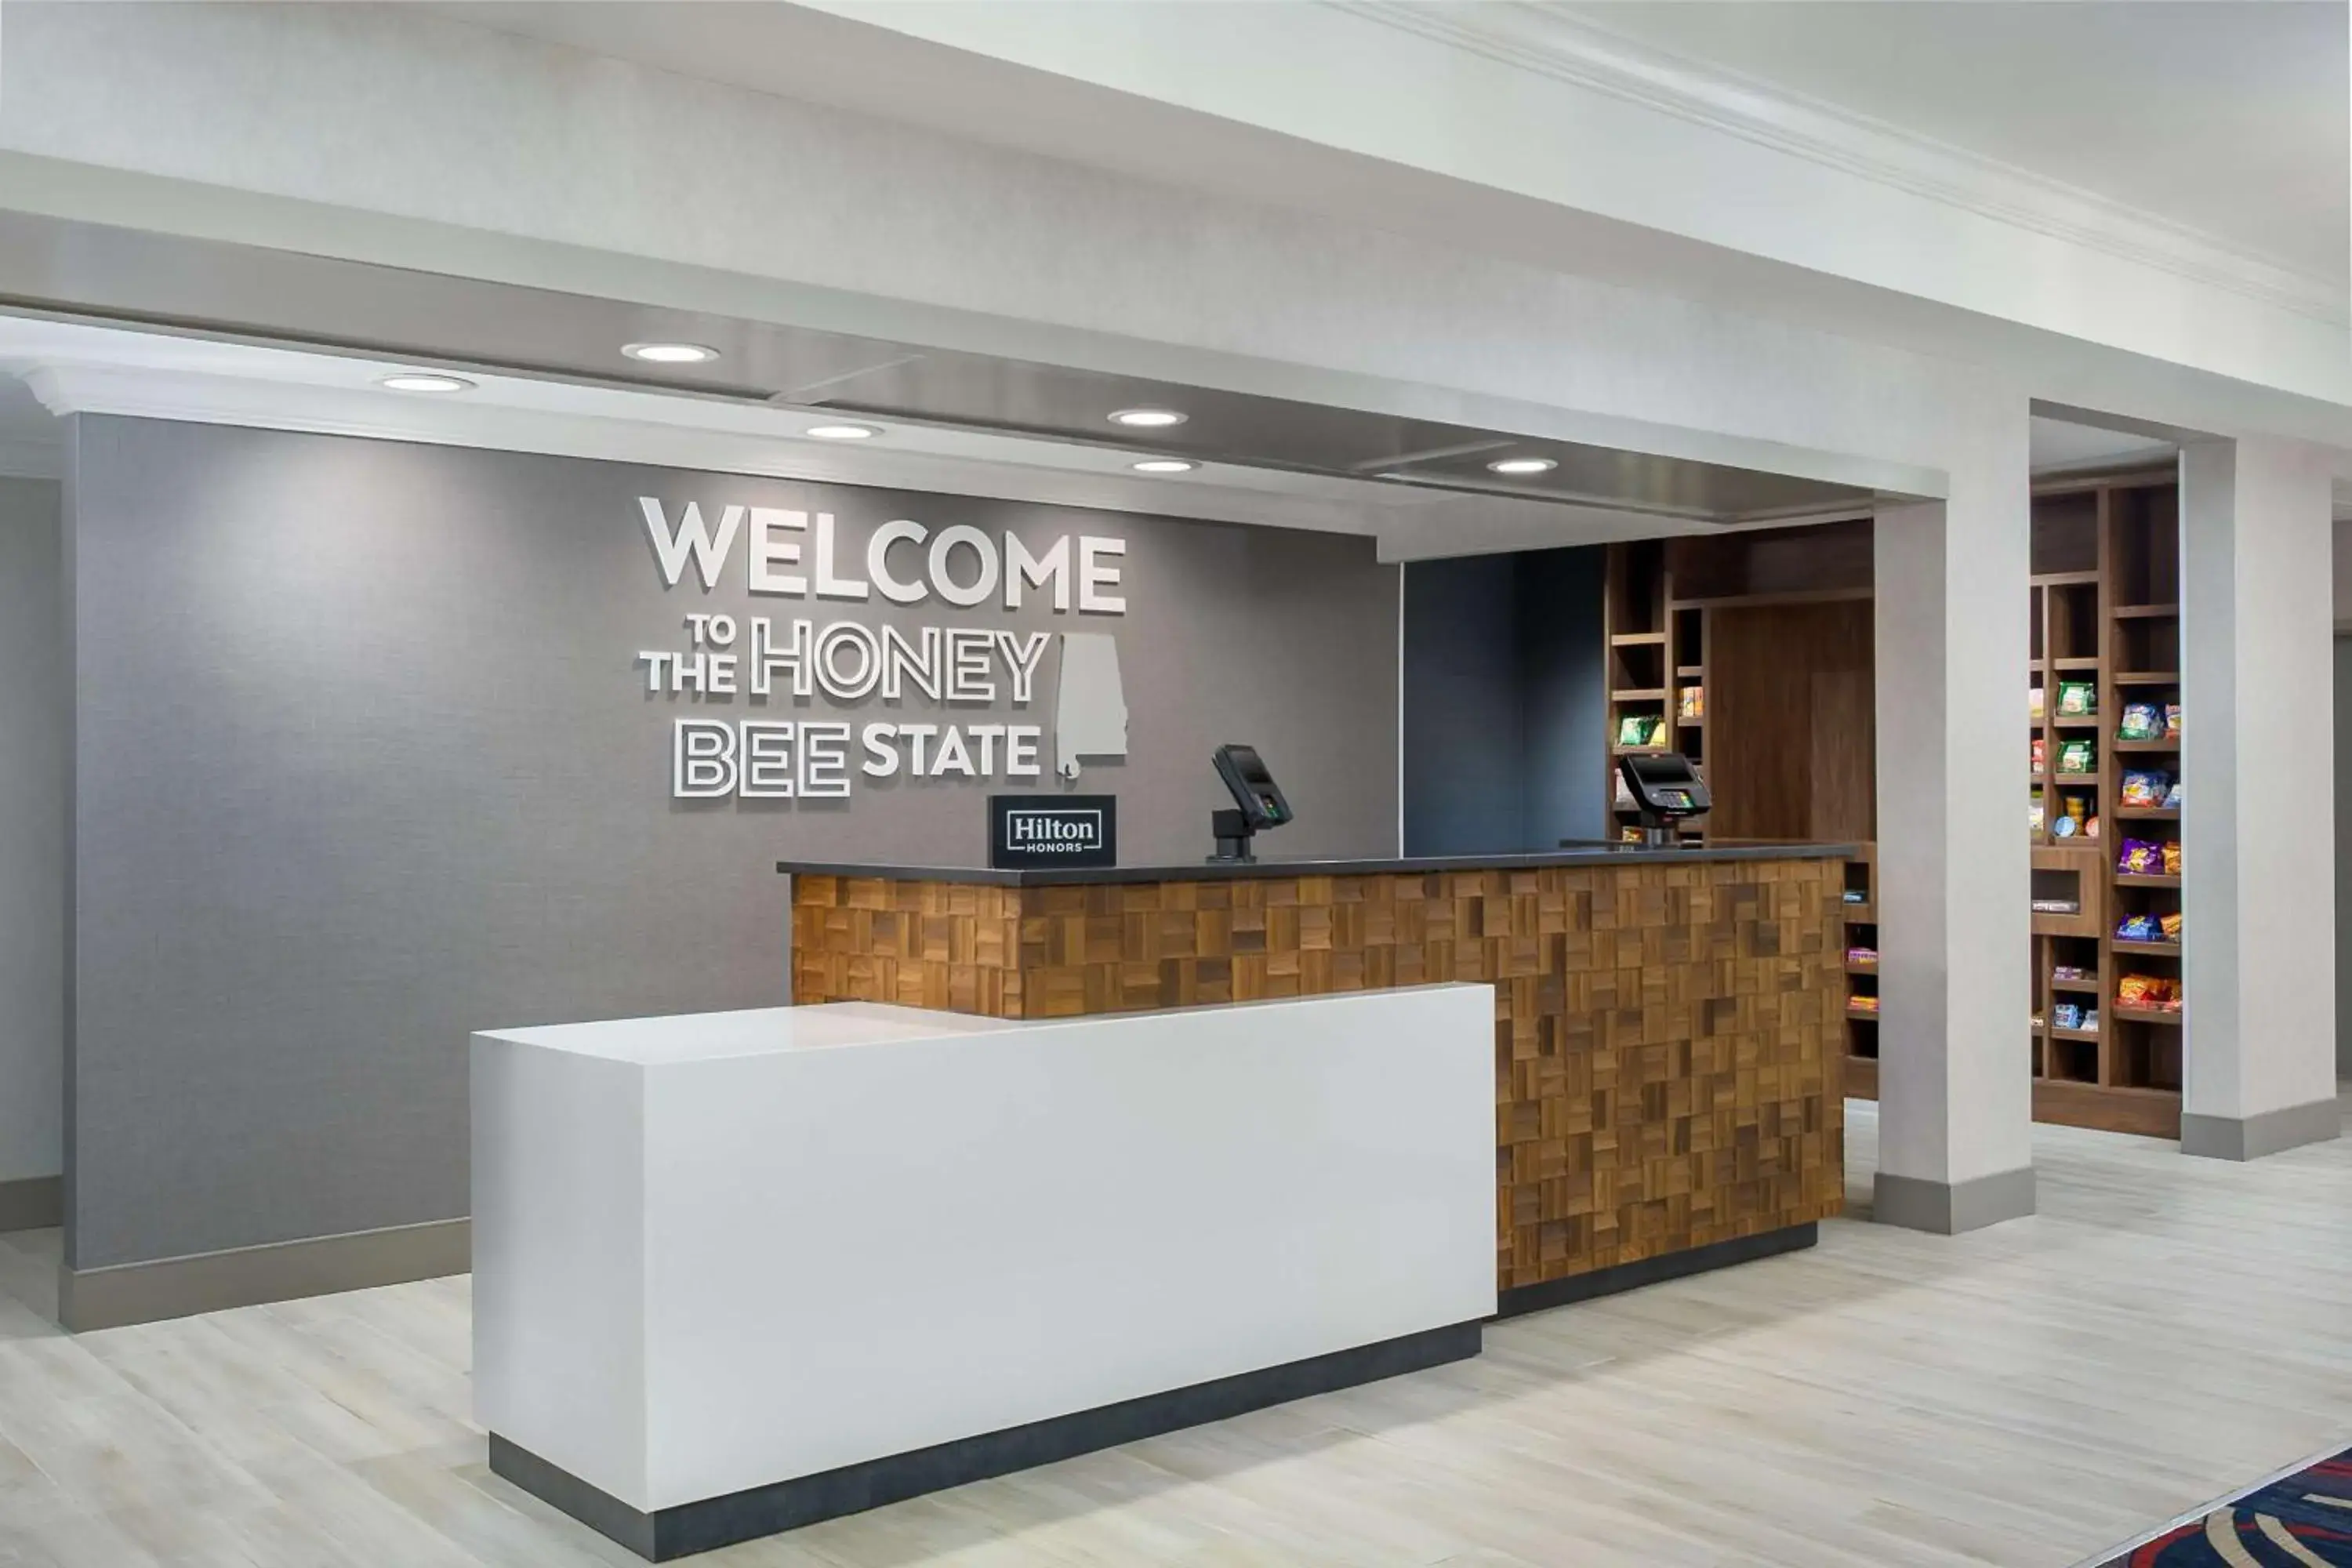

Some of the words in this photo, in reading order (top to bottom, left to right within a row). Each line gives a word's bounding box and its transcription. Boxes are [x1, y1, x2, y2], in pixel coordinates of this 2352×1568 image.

[640, 497, 1126, 614] WELCOME
[685, 614, 736, 644] TO
[639, 652, 737, 693] THE
[750, 617, 1051, 702] HONEY
[674, 719, 851, 797] BEE
[862, 723, 1041, 777] STATE
[1015, 818, 1094, 840] Hilton
[1027, 843, 1083, 852] HONORS
